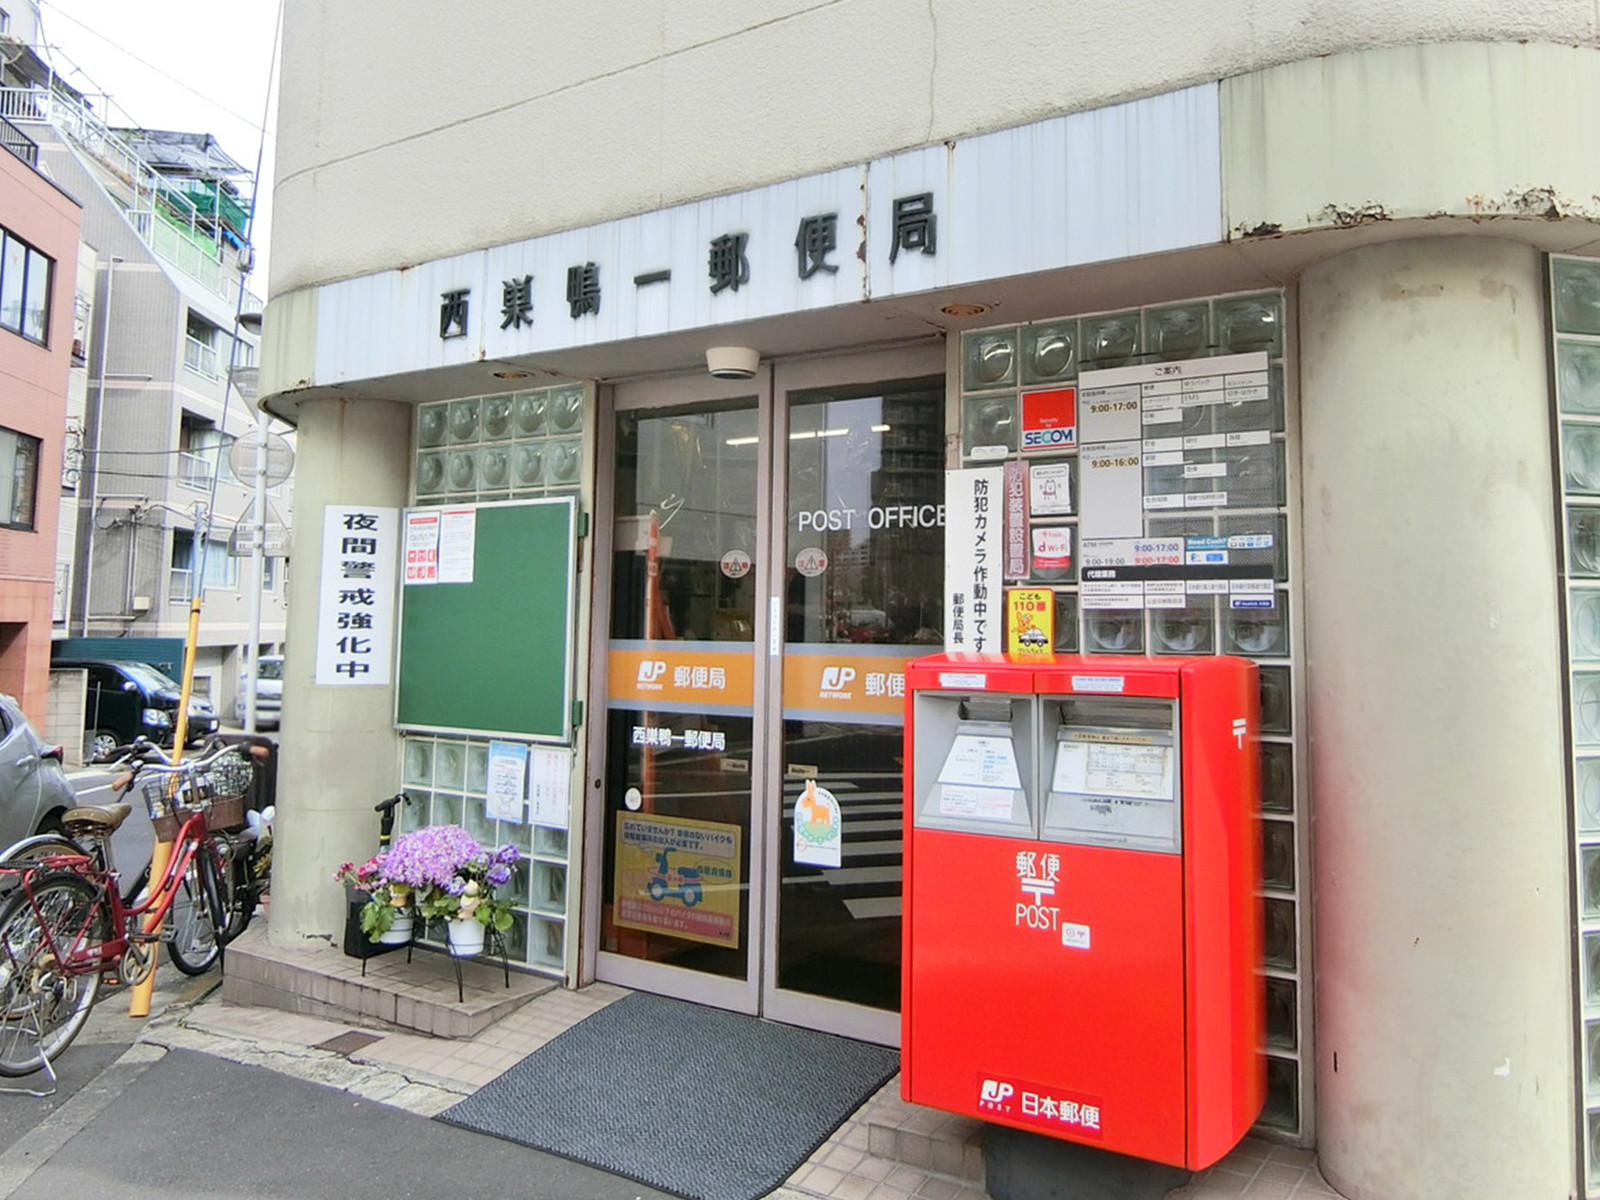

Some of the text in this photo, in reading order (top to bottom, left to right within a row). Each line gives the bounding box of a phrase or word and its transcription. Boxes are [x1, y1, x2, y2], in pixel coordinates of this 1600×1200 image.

[439, 191, 938, 339] 西巣鴨一郵便局
[1154, 365, 1182, 377] ご案内
[1090, 401, 1138, 414] 9:00-17:00
[1025, 429, 1073, 445] SECOM
[1091, 457, 1140, 469] 9:00-16:00
[798, 504, 946, 532] POST OFFICE
[1134, 543, 1179, 552] 9:00-17:00
[973, 479, 989, 652] 防犯カメラ作動中です
[335, 513, 379, 678] 夜間警戒強化中
[1019, 592, 1042, 600] こども
[952, 593, 965, 645] 郵便局長
[674, 666, 726, 690] 郵便局
[632, 726, 726, 751] 西巣鴨一郵便局
[1015, 851, 1060, 882] 郵便
[1015, 903, 1060, 931] POST
[979, 1100, 1011, 1112] POST
[1022, 1091, 1100, 1129] 日本郵便
